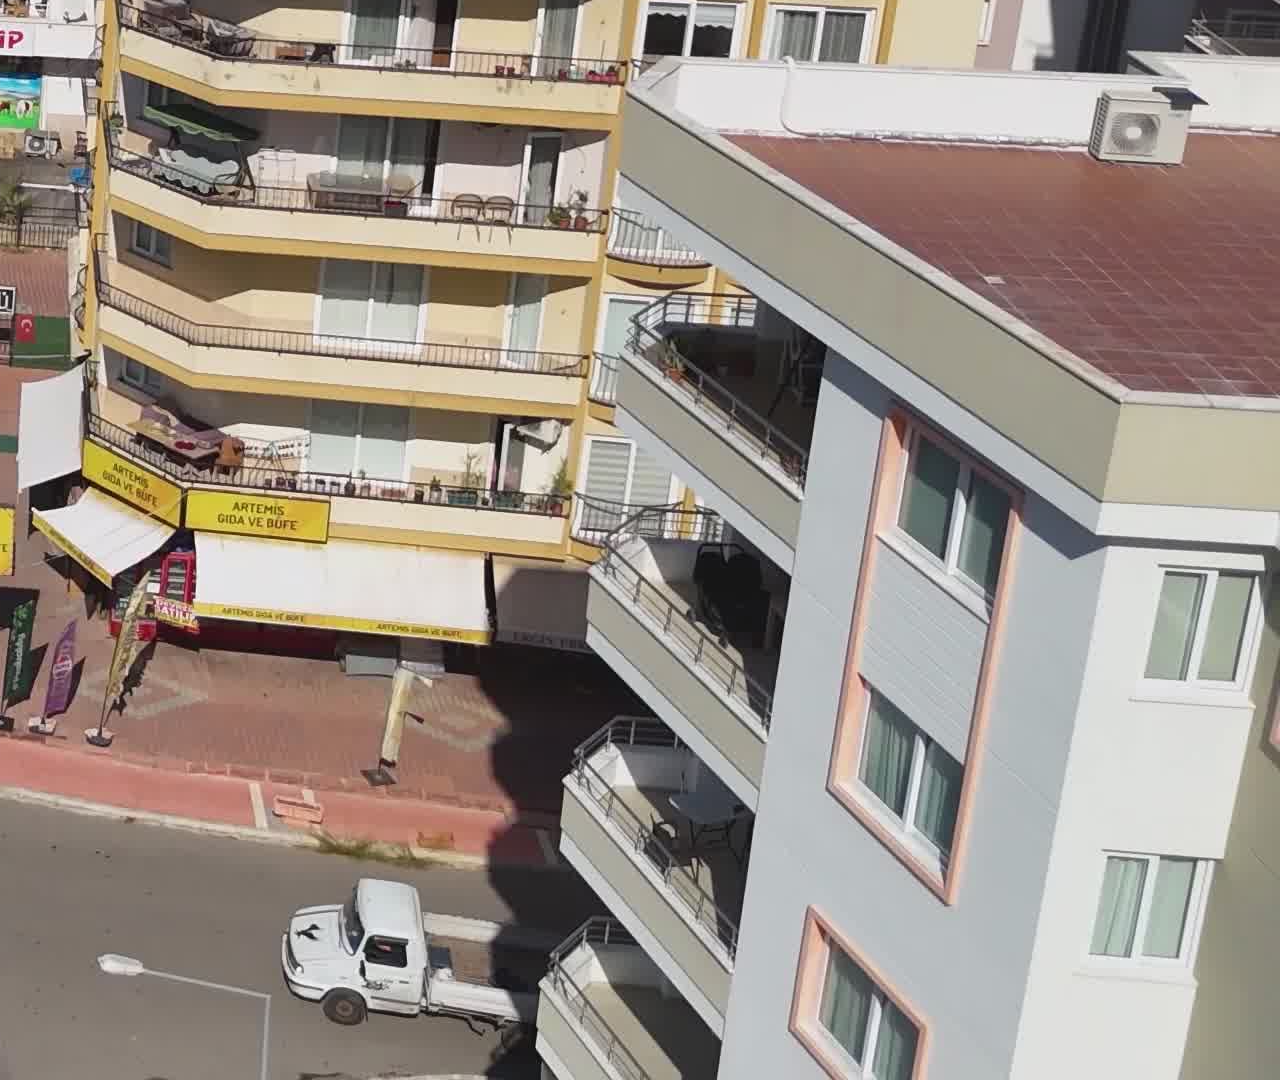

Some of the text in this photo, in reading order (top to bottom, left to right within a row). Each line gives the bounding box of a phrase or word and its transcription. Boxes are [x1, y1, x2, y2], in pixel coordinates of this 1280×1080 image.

[123, 482, 133, 495] VE
[217, 513, 245, 525] GIDA
[248, 516, 263, 528] VE
